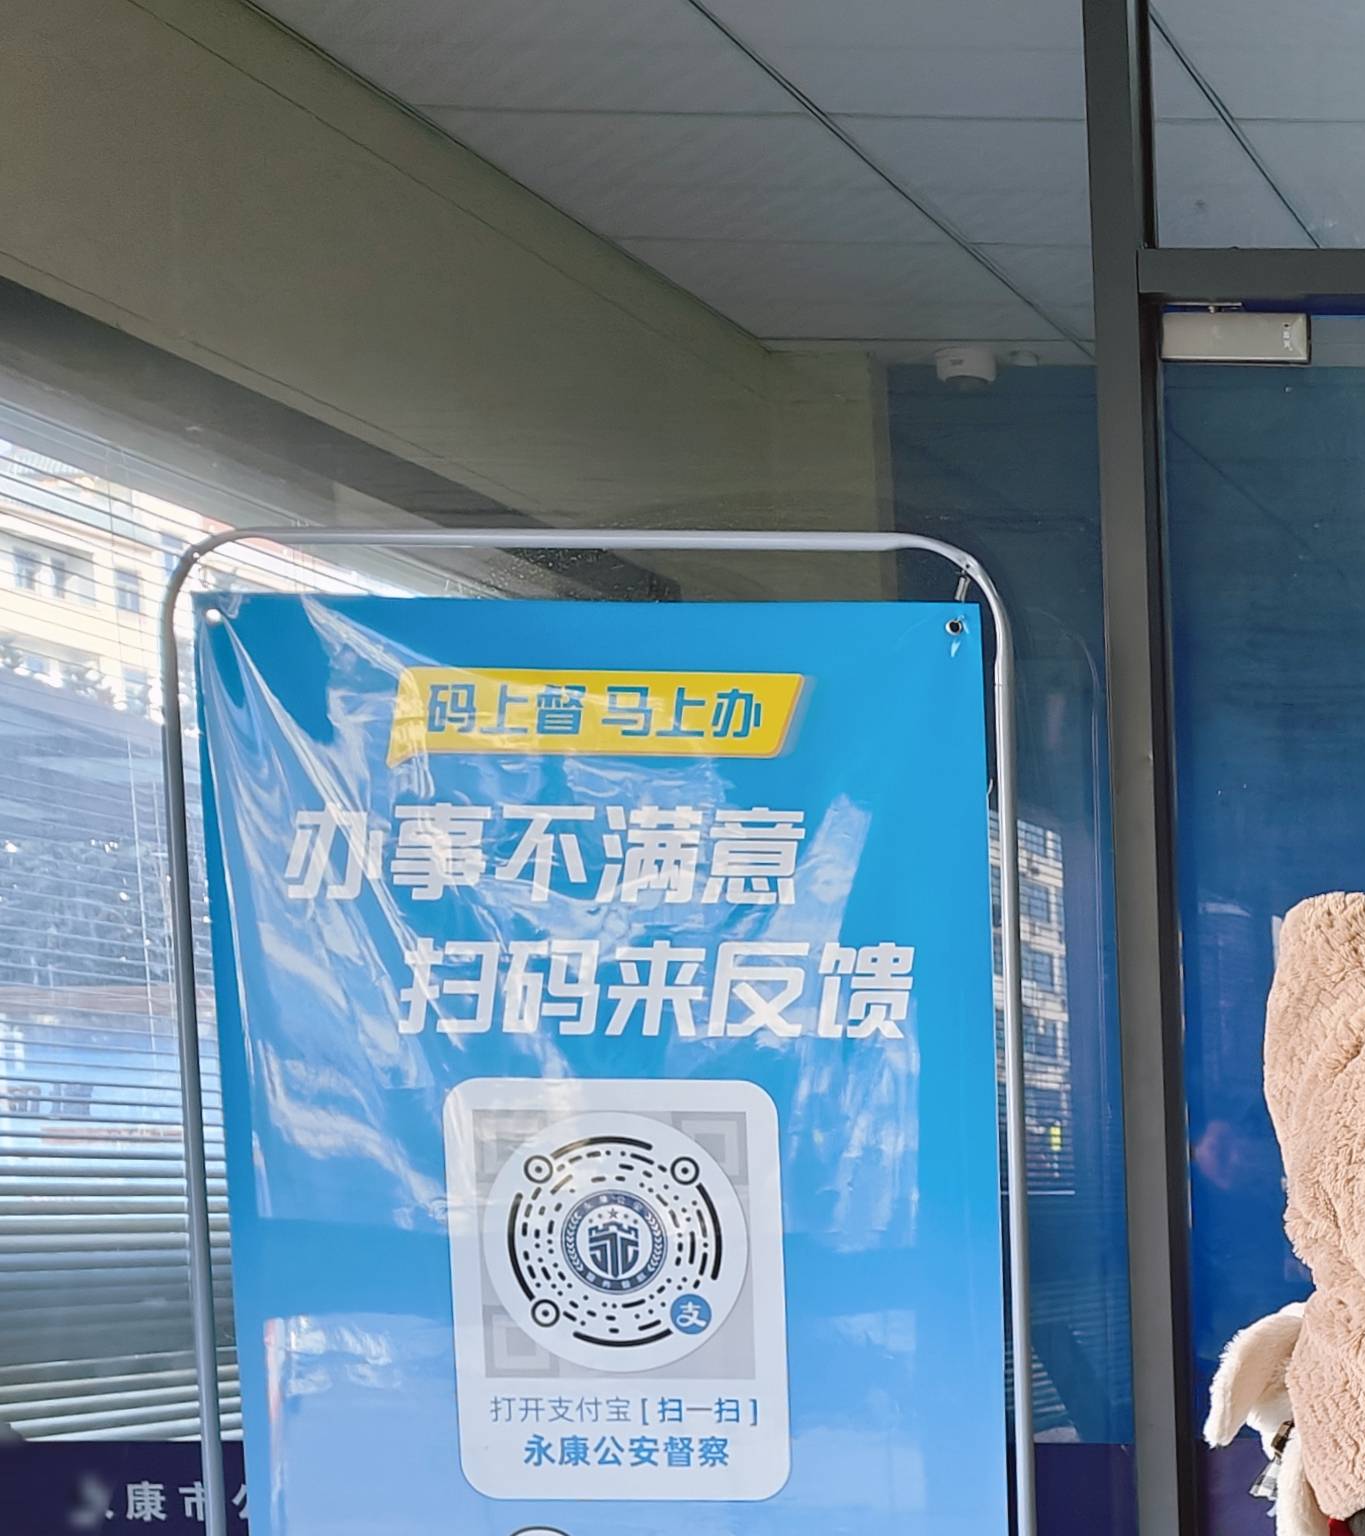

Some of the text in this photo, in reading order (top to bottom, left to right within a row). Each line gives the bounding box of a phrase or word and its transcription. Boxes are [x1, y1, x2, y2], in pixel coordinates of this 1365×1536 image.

[426, 683, 762, 739] 码上督 马上办
[284, 804, 808, 904] 办事不满意
[399, 940, 916, 1039] 扫码来反馈
[524, 1434, 730, 1468] 永康公安督察
